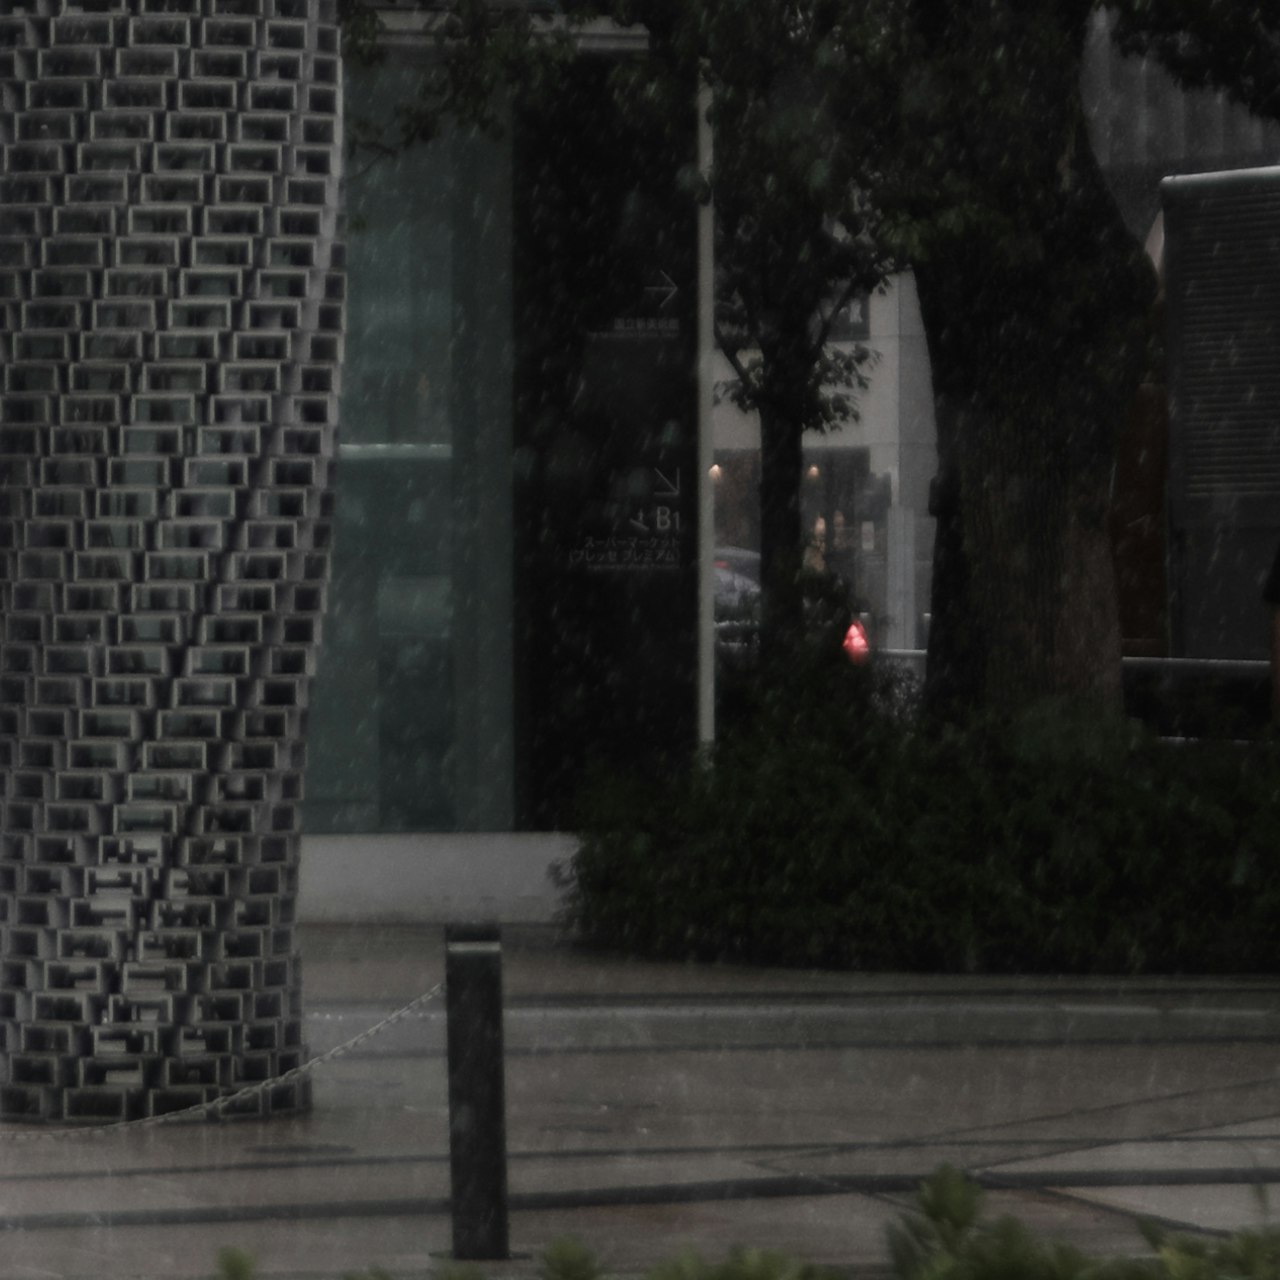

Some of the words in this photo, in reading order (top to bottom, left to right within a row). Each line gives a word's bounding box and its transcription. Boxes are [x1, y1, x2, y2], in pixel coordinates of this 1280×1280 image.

[656, 506, 680, 530] B1
[584, 536, 680, 548] スーパーマーケット
